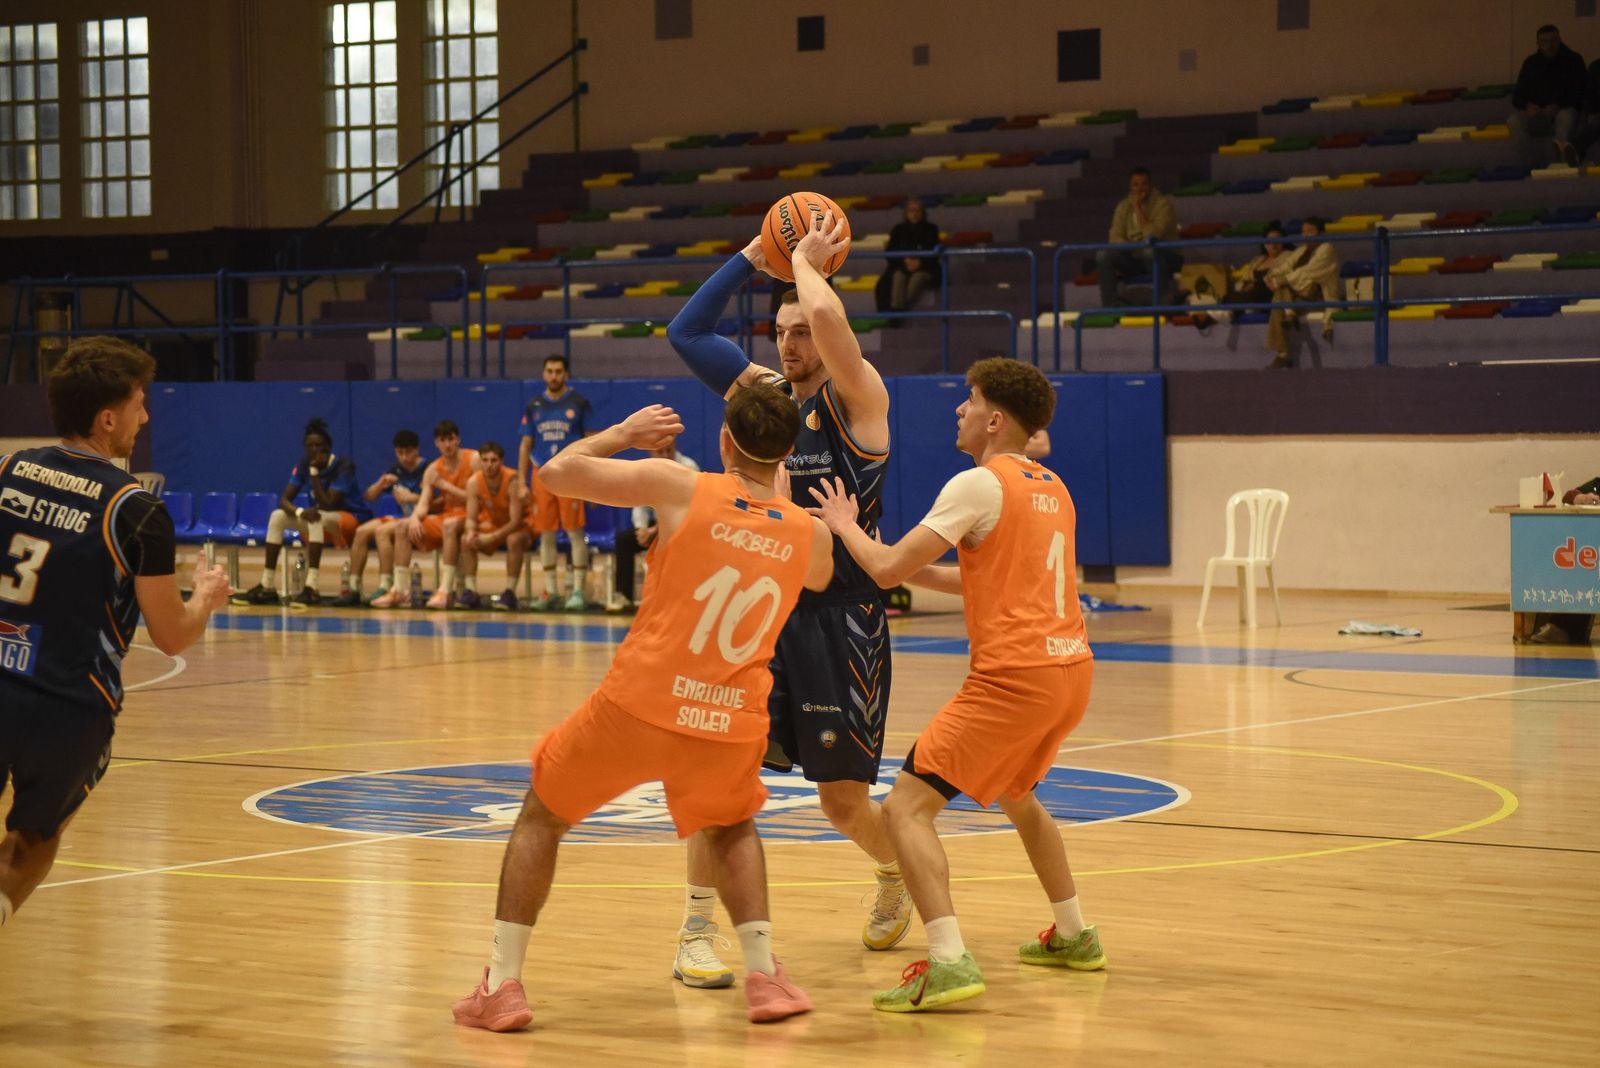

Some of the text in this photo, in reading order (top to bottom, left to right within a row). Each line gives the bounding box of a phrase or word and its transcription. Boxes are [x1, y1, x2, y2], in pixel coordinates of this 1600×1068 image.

[32, 499, 91, 533] STROG
[0, 532, 51, 605] 3
[1046, 531, 1065, 619] 1
[1553, 536, 1600, 578] de
[688, 564, 782, 665] 10
[672, 674, 746, 709] ENRIQUE
[676, 705, 731, 733] SOLER
